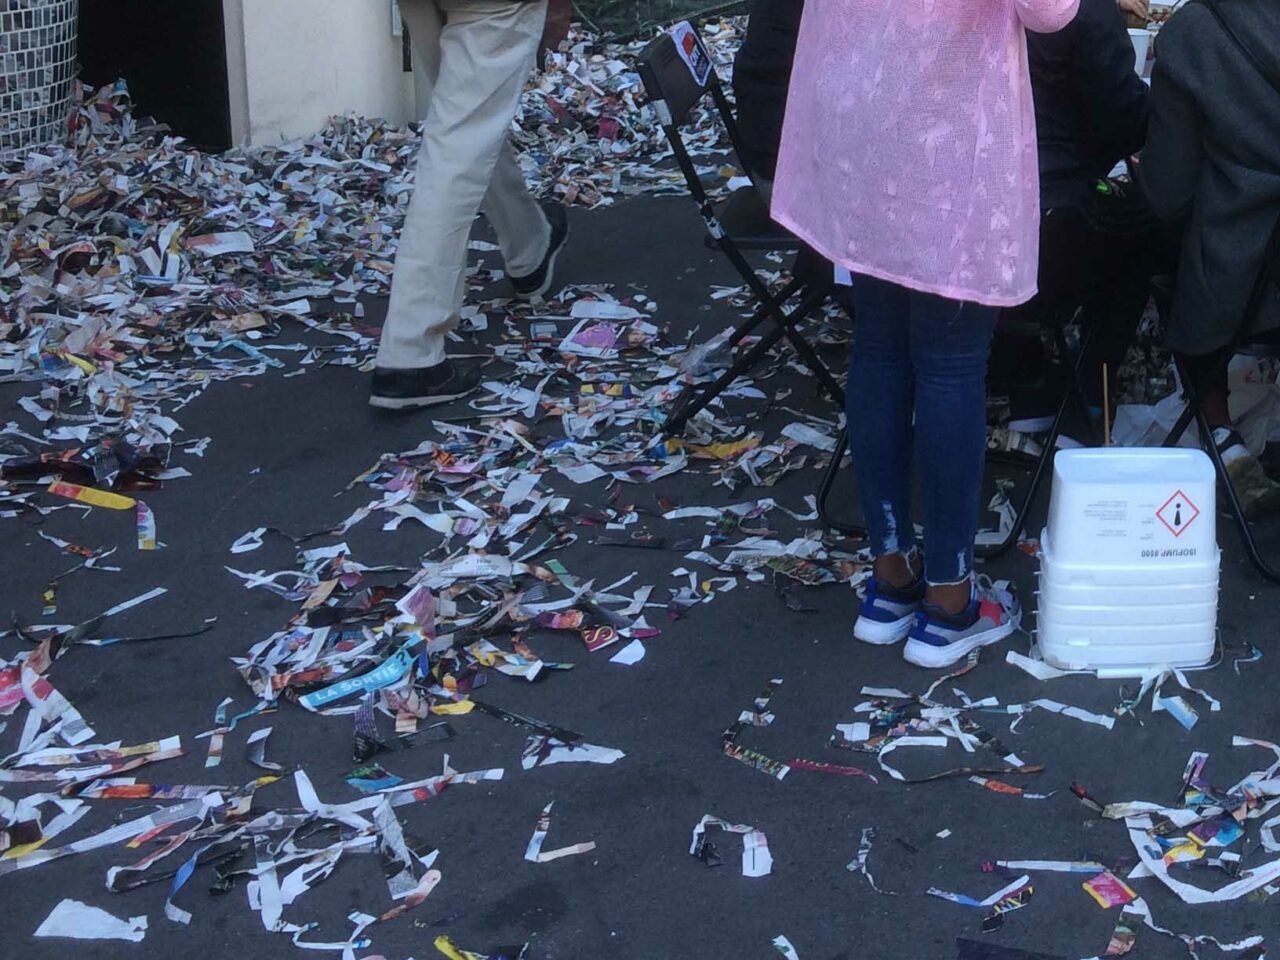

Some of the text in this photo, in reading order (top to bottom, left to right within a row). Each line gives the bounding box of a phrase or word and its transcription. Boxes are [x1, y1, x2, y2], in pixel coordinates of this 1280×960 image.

[1160, 549, 1197, 557] ISOPUMP
[315, 689, 339, 701] LA
[340, 663, 399, 692] SORTIE
